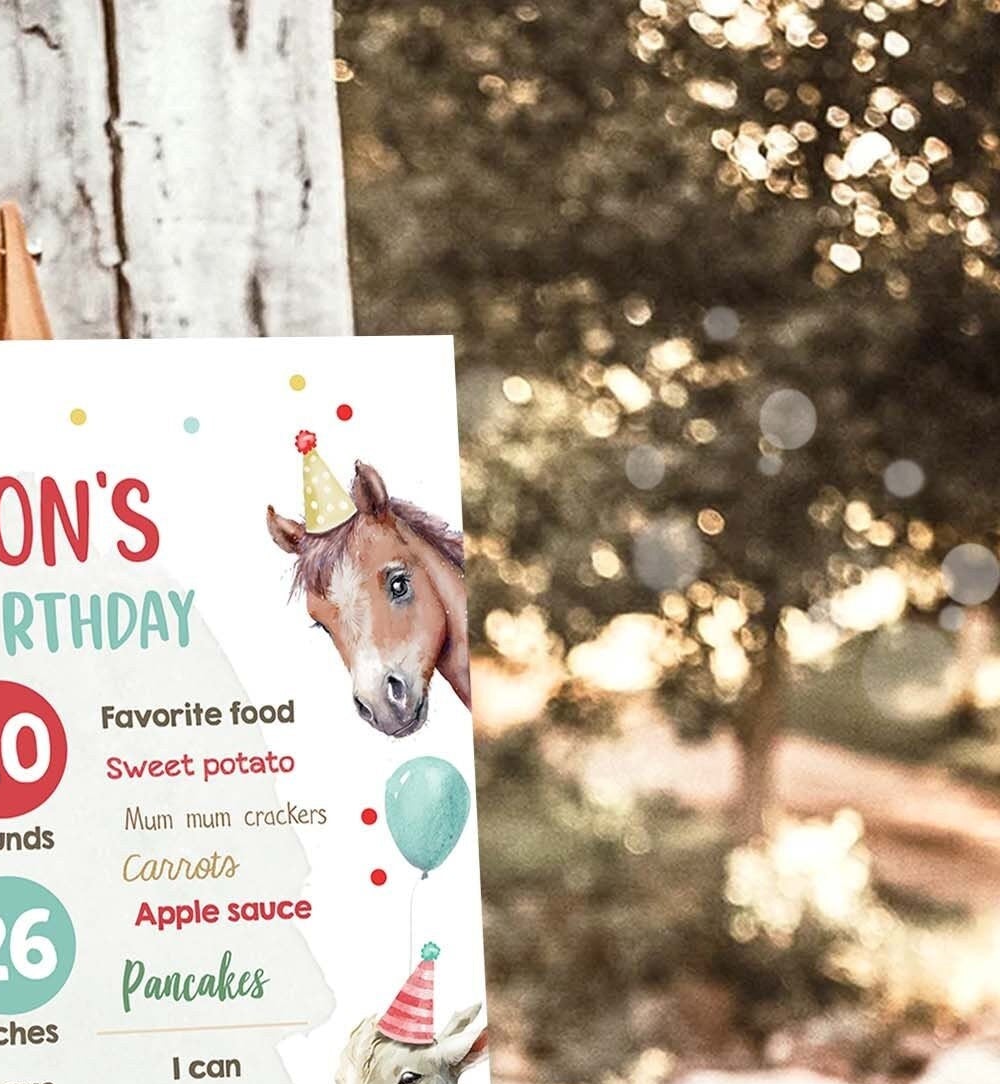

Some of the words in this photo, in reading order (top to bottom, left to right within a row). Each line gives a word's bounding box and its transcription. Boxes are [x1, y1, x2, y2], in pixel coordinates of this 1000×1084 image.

[101, 701, 223, 730] Favorite
[229, 699, 295, 726] food
[106, 753, 196, 780] Sweet
[203, 751, 295, 783] potato
[124, 805, 174, 831] Mum
[186, 811, 232, 829] mum
[244, 801, 327, 827] crackers
[122, 851, 241, 883] Carrots
[134, 899, 220, 932] Apple
[227, 899, 313, 923] sauce
[122, 950, 271, 1014] Pancakes
[172, 1056, 181, 1081] I
[188, 1058, 242, 1080] can
